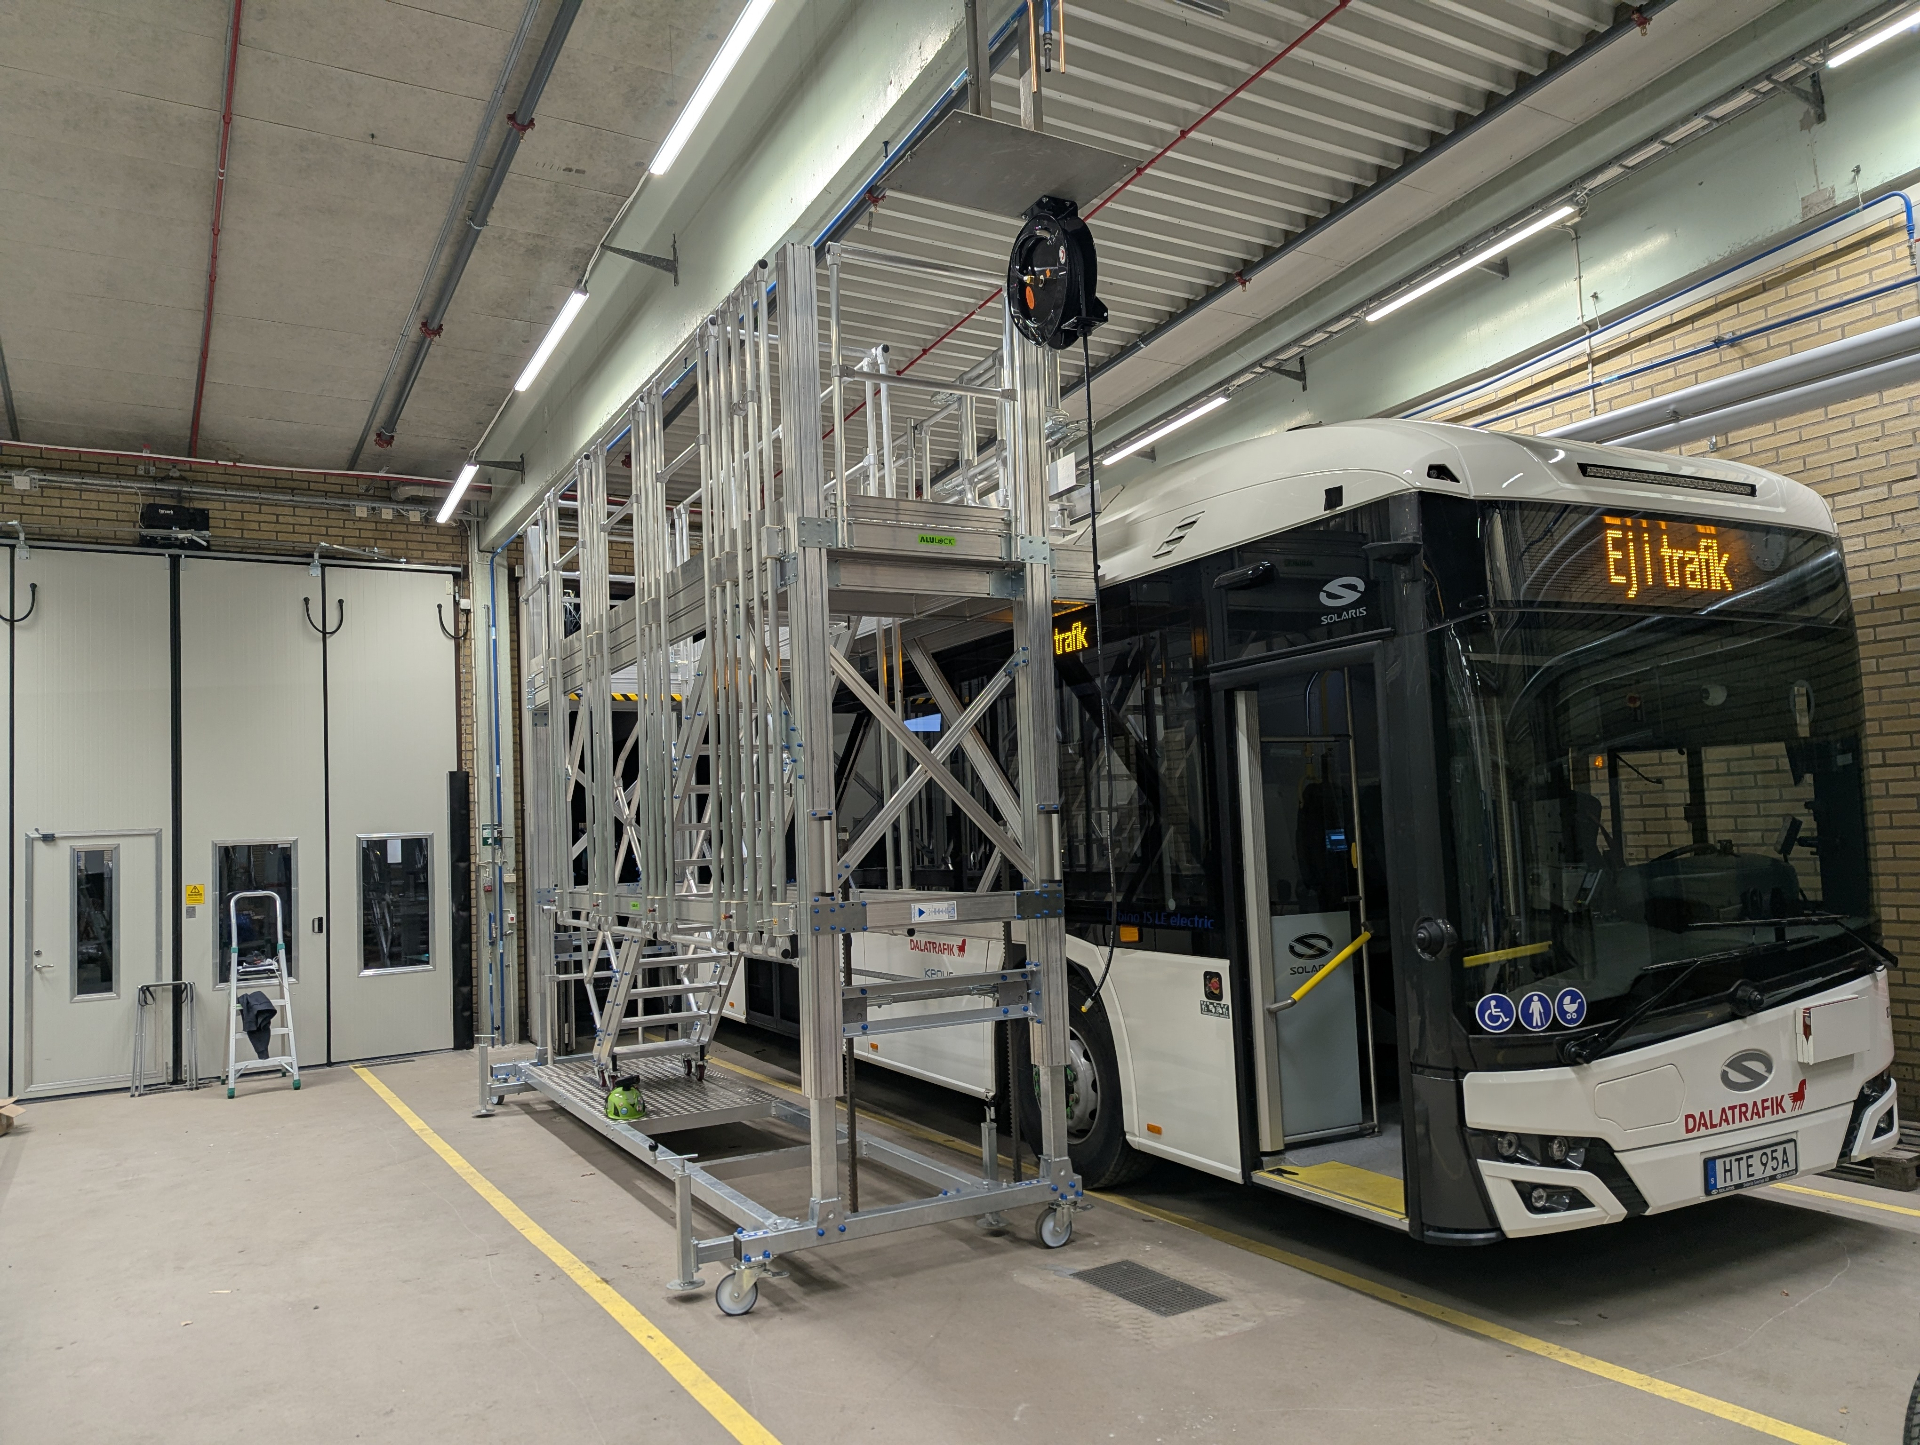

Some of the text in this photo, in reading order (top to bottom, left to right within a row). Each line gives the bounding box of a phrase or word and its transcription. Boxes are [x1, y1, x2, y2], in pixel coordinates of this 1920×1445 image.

[1606, 530, 1732, 598] Ej i trafik
[1320, 606, 1367, 625] SOLARIS
[1053, 621, 1089, 655] trafik
[1106, 908, 1140, 924] Ubino
[1155, 911, 1168, 925] LE
[1170, 913, 1215, 929] electric
[909, 938, 956, 957] DALATRAFIK
[1684, 1094, 1787, 1135] DALATRAFIK
[1722, 1146, 1791, 1184] HTE 95A
